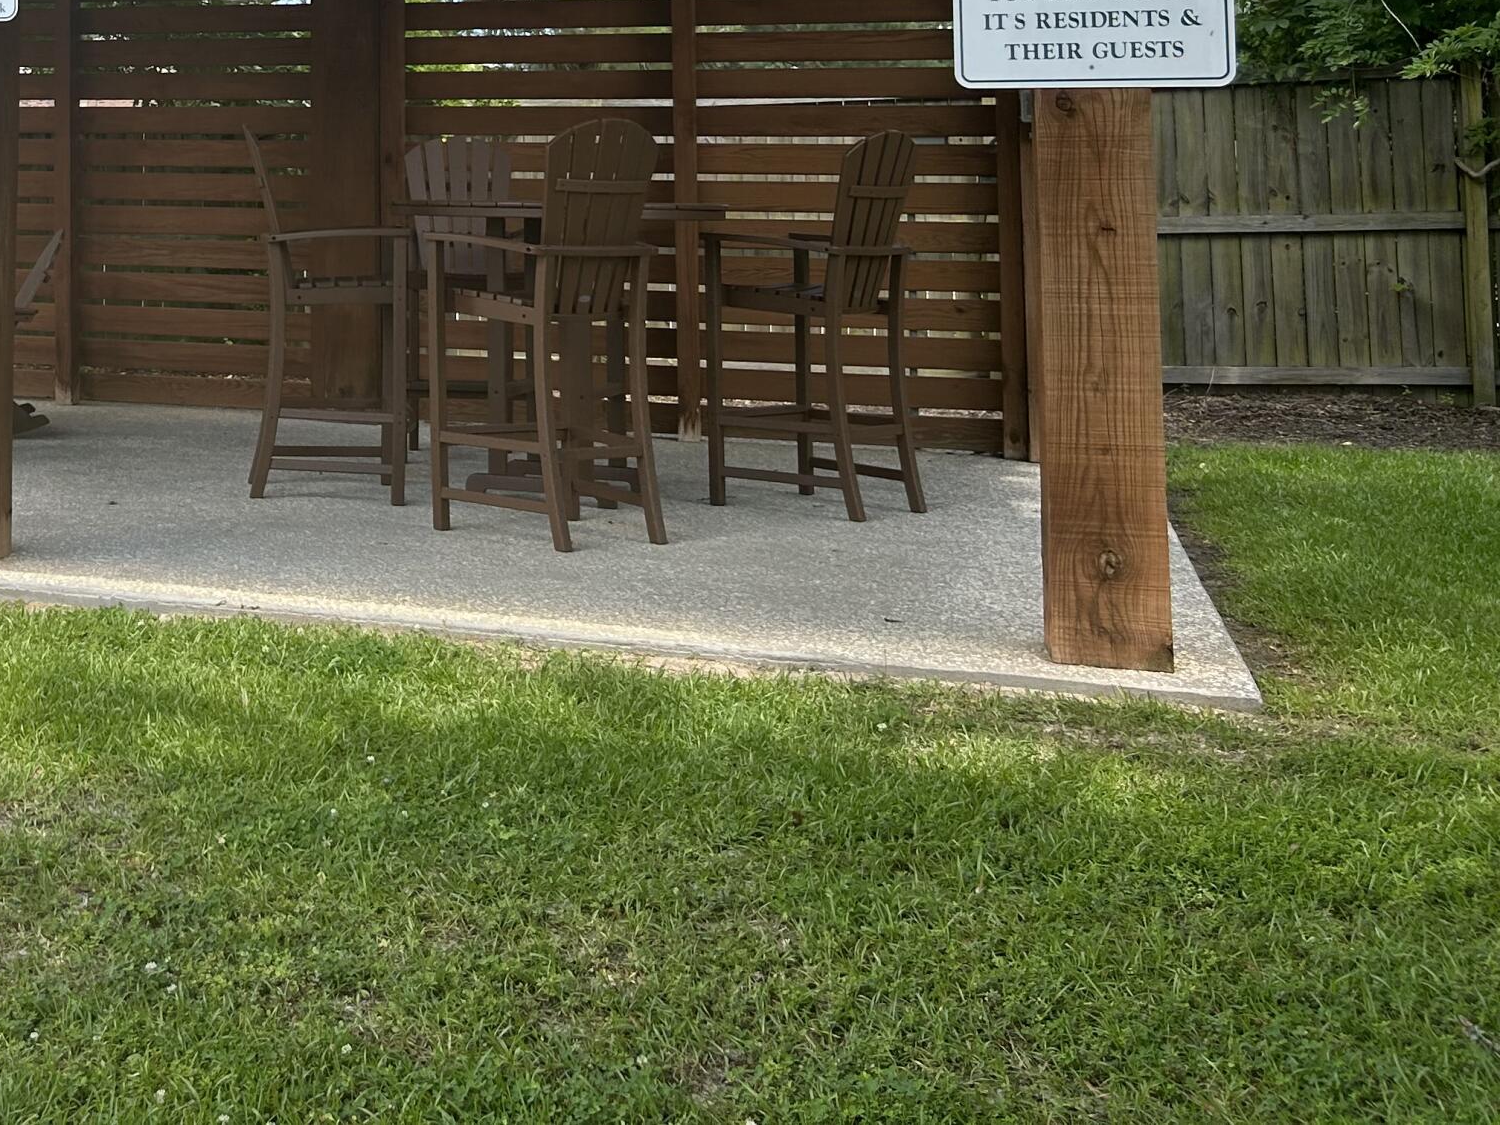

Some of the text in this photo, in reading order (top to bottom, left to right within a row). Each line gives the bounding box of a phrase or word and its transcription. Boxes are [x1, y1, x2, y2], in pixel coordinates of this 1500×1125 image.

[1035, 10, 1170, 29] RESIDENTS
[1180, 9, 1202, 26] &
[1004, 40, 1184, 60] THEIR GUESTS
